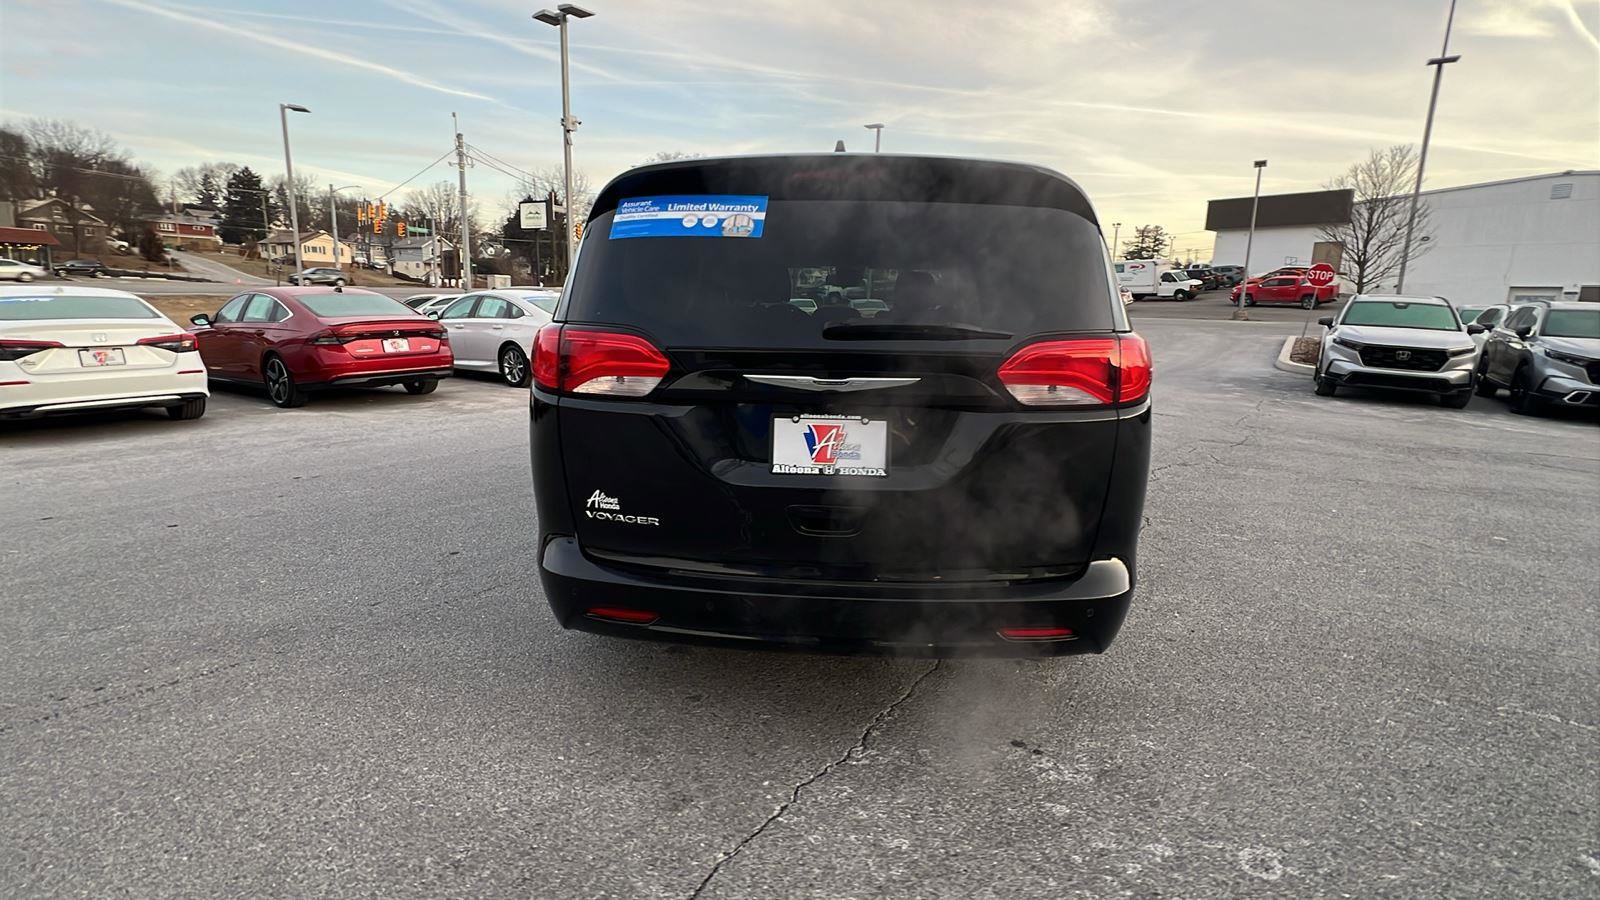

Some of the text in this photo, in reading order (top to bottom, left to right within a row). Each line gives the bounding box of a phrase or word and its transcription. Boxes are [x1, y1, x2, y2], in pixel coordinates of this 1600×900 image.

[621, 206, 644, 214] Vehicle
[667, 202, 759, 213] Limited Warranty
[1308, 270, 1334, 280] STOP
[772, 464, 820, 474] Altoona
[839, 467, 887, 476] HONDA
[585, 510, 660, 526] VOYAGER
